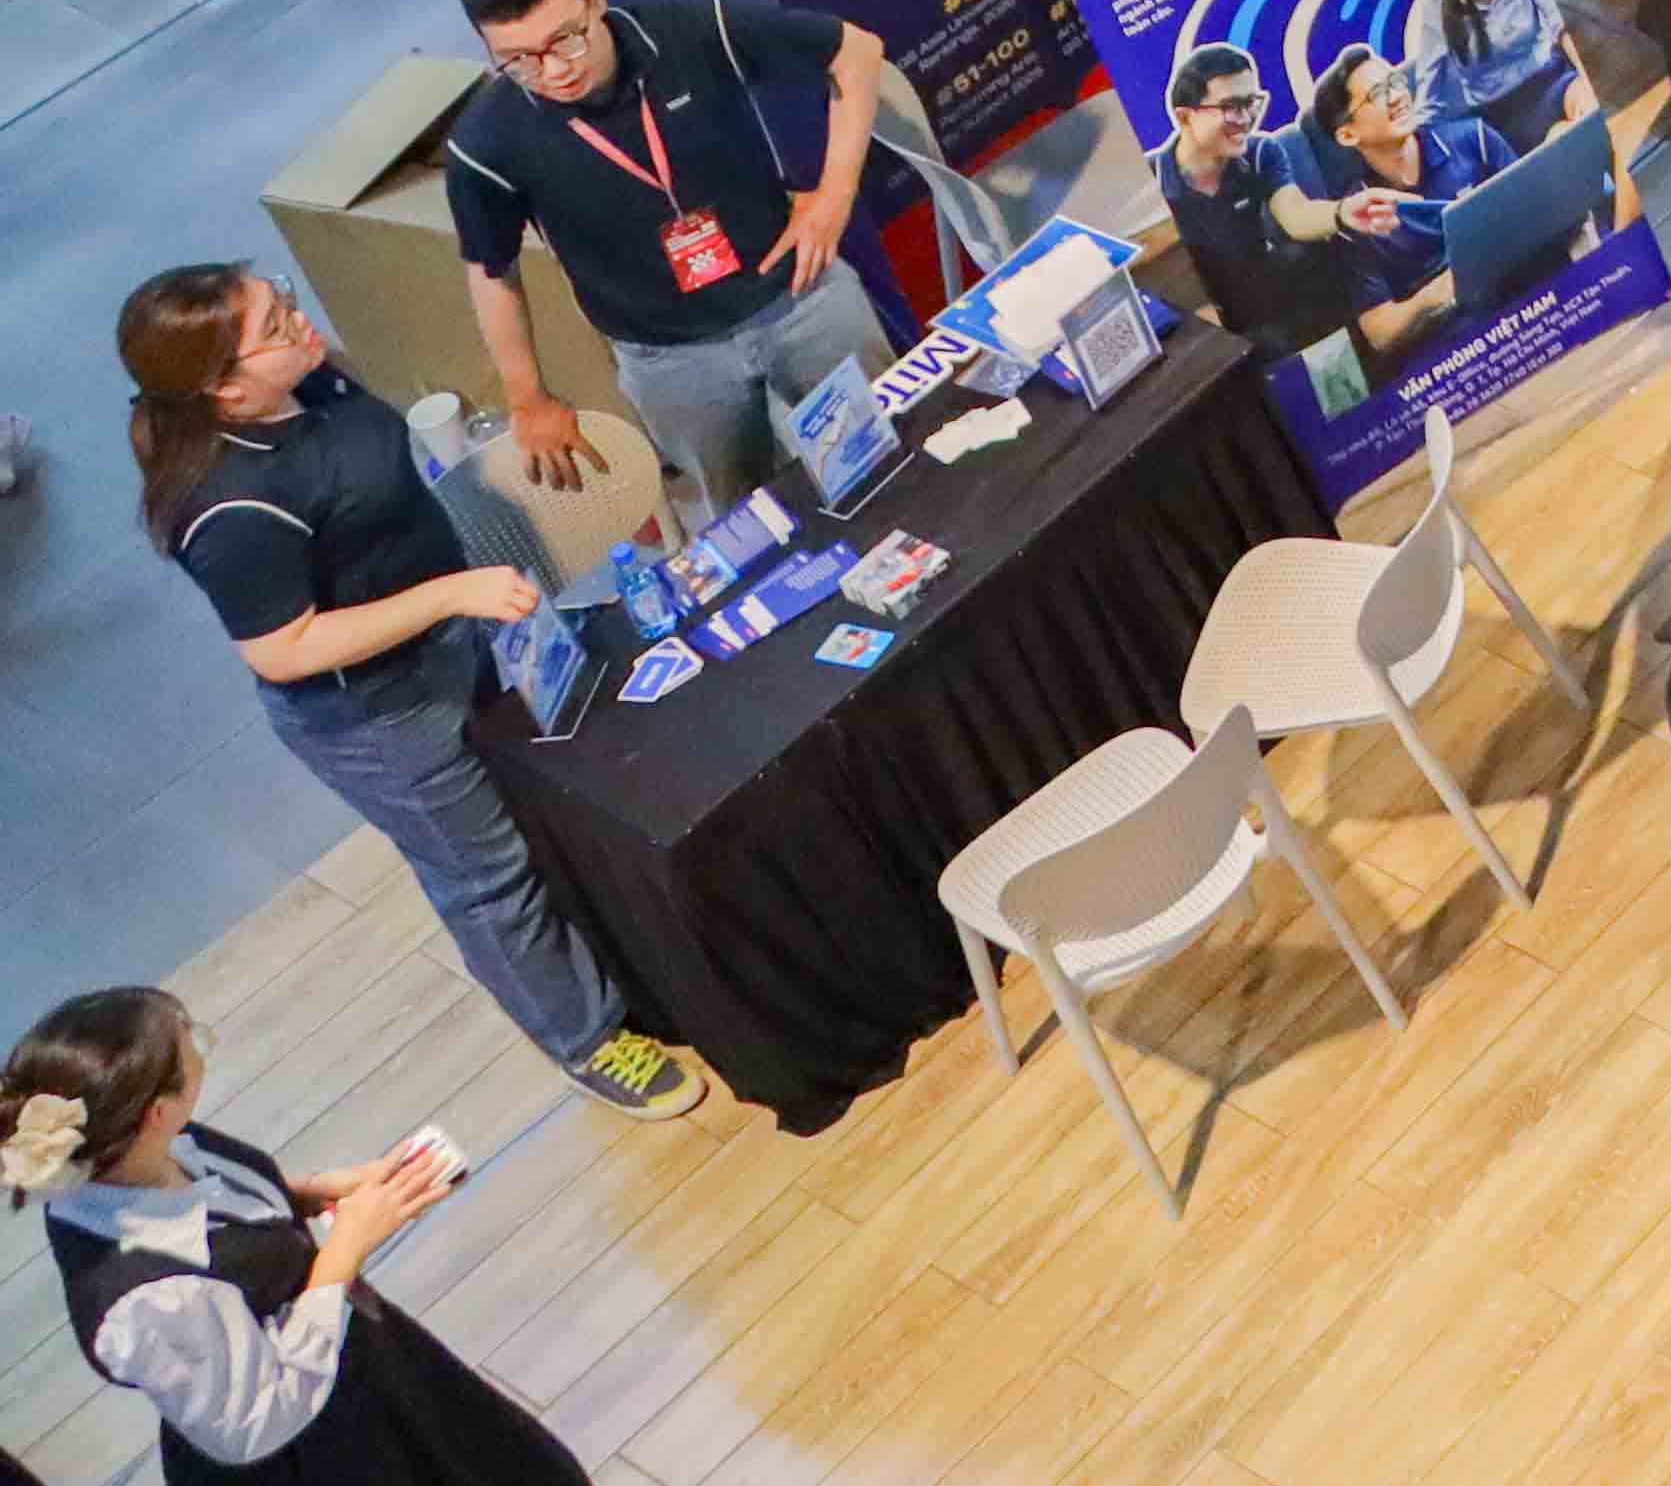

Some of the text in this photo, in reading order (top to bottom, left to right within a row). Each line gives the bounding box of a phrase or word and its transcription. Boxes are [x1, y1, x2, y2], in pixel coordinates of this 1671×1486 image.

[1393, 292, 1562, 396] VĂN PHÒNG VIỆT NAM
